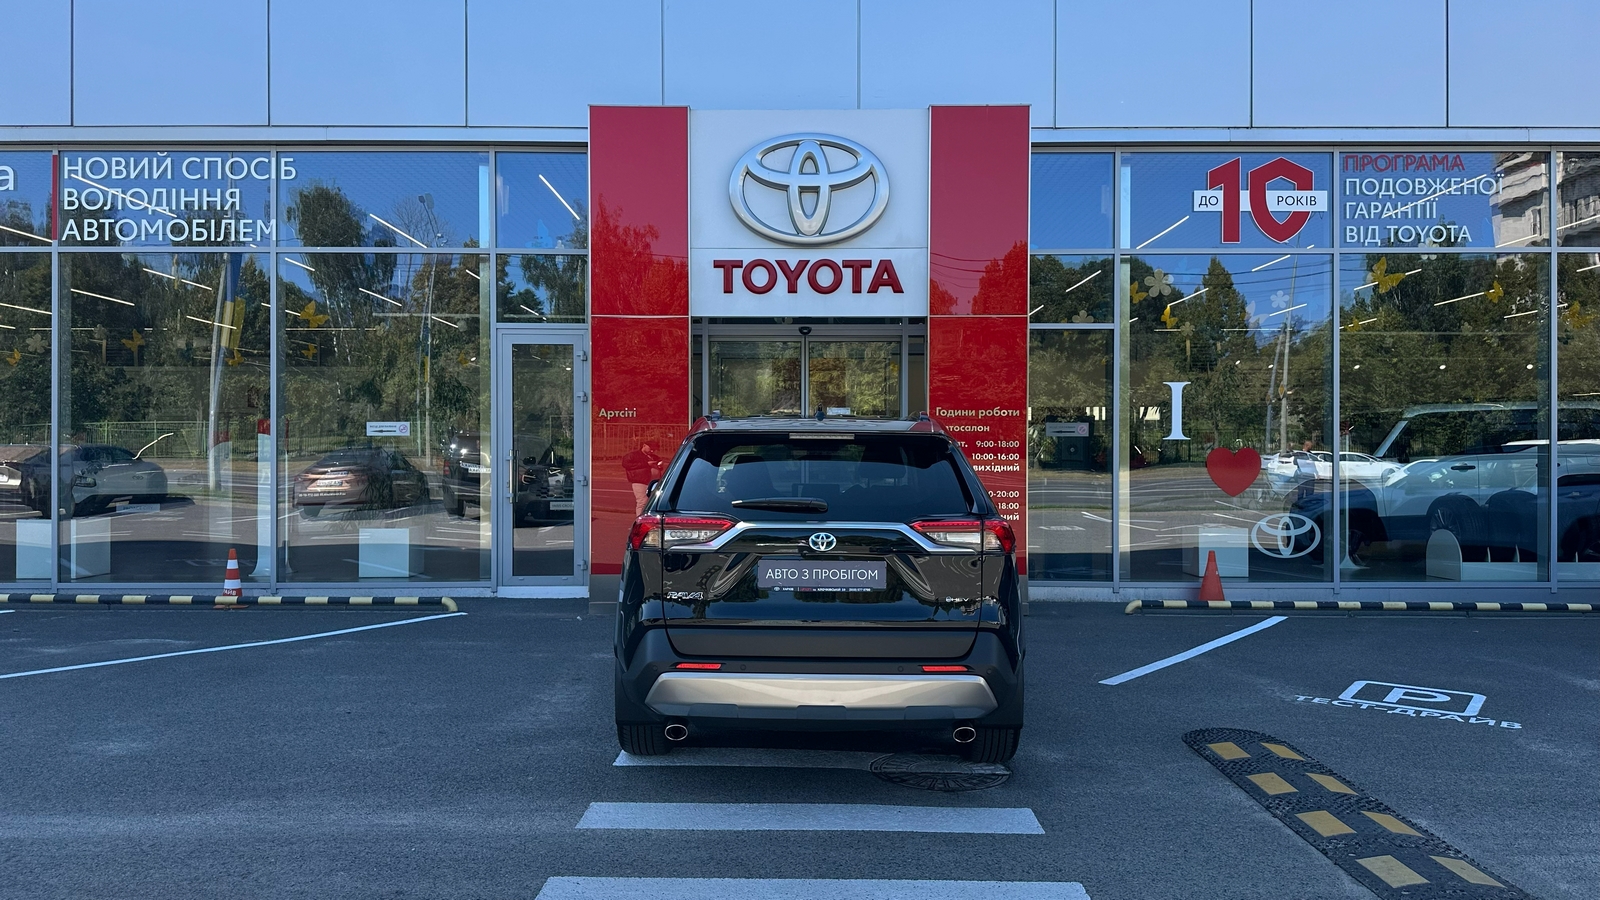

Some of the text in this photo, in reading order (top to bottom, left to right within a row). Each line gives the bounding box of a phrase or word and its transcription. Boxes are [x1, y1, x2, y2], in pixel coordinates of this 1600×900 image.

[64, 152, 296, 179] НОВИЙ СПОСІБ
[1345, 154, 1465, 172] ПРОГРАМА
[1346, 174, 1504, 199] ПОДОВЖЕНОЇ
[64, 188, 240, 215] ВОЛОДІННЯ
[1198, 156, 1317, 244] ДО 10 РОКІВ
[1346, 197, 1438, 219] ГАРАНТІЇ
[61, 218, 277, 242] АВТОМОБІЛЕМ
[1346, 225, 1472, 246] ВІД TOYOTA
[713, 258, 905, 294] TOYOTA
[599, 407, 636, 420] Артсіті
[936, 407, 1020, 418] Години роботи
[971, 453, 1020, 461] 10:00-16:00
[972, 462, 1020, 472] вихідний
[987, 490, 1020, 498] 0-20:00
[765, 568, 799, 580] АВТО
[812, 569, 879, 580] ПРОБІГОМ
[1383, 687, 1451, 703] P
[1294, 694, 1523, 730] ТЕСТ-ДРАЙВ
